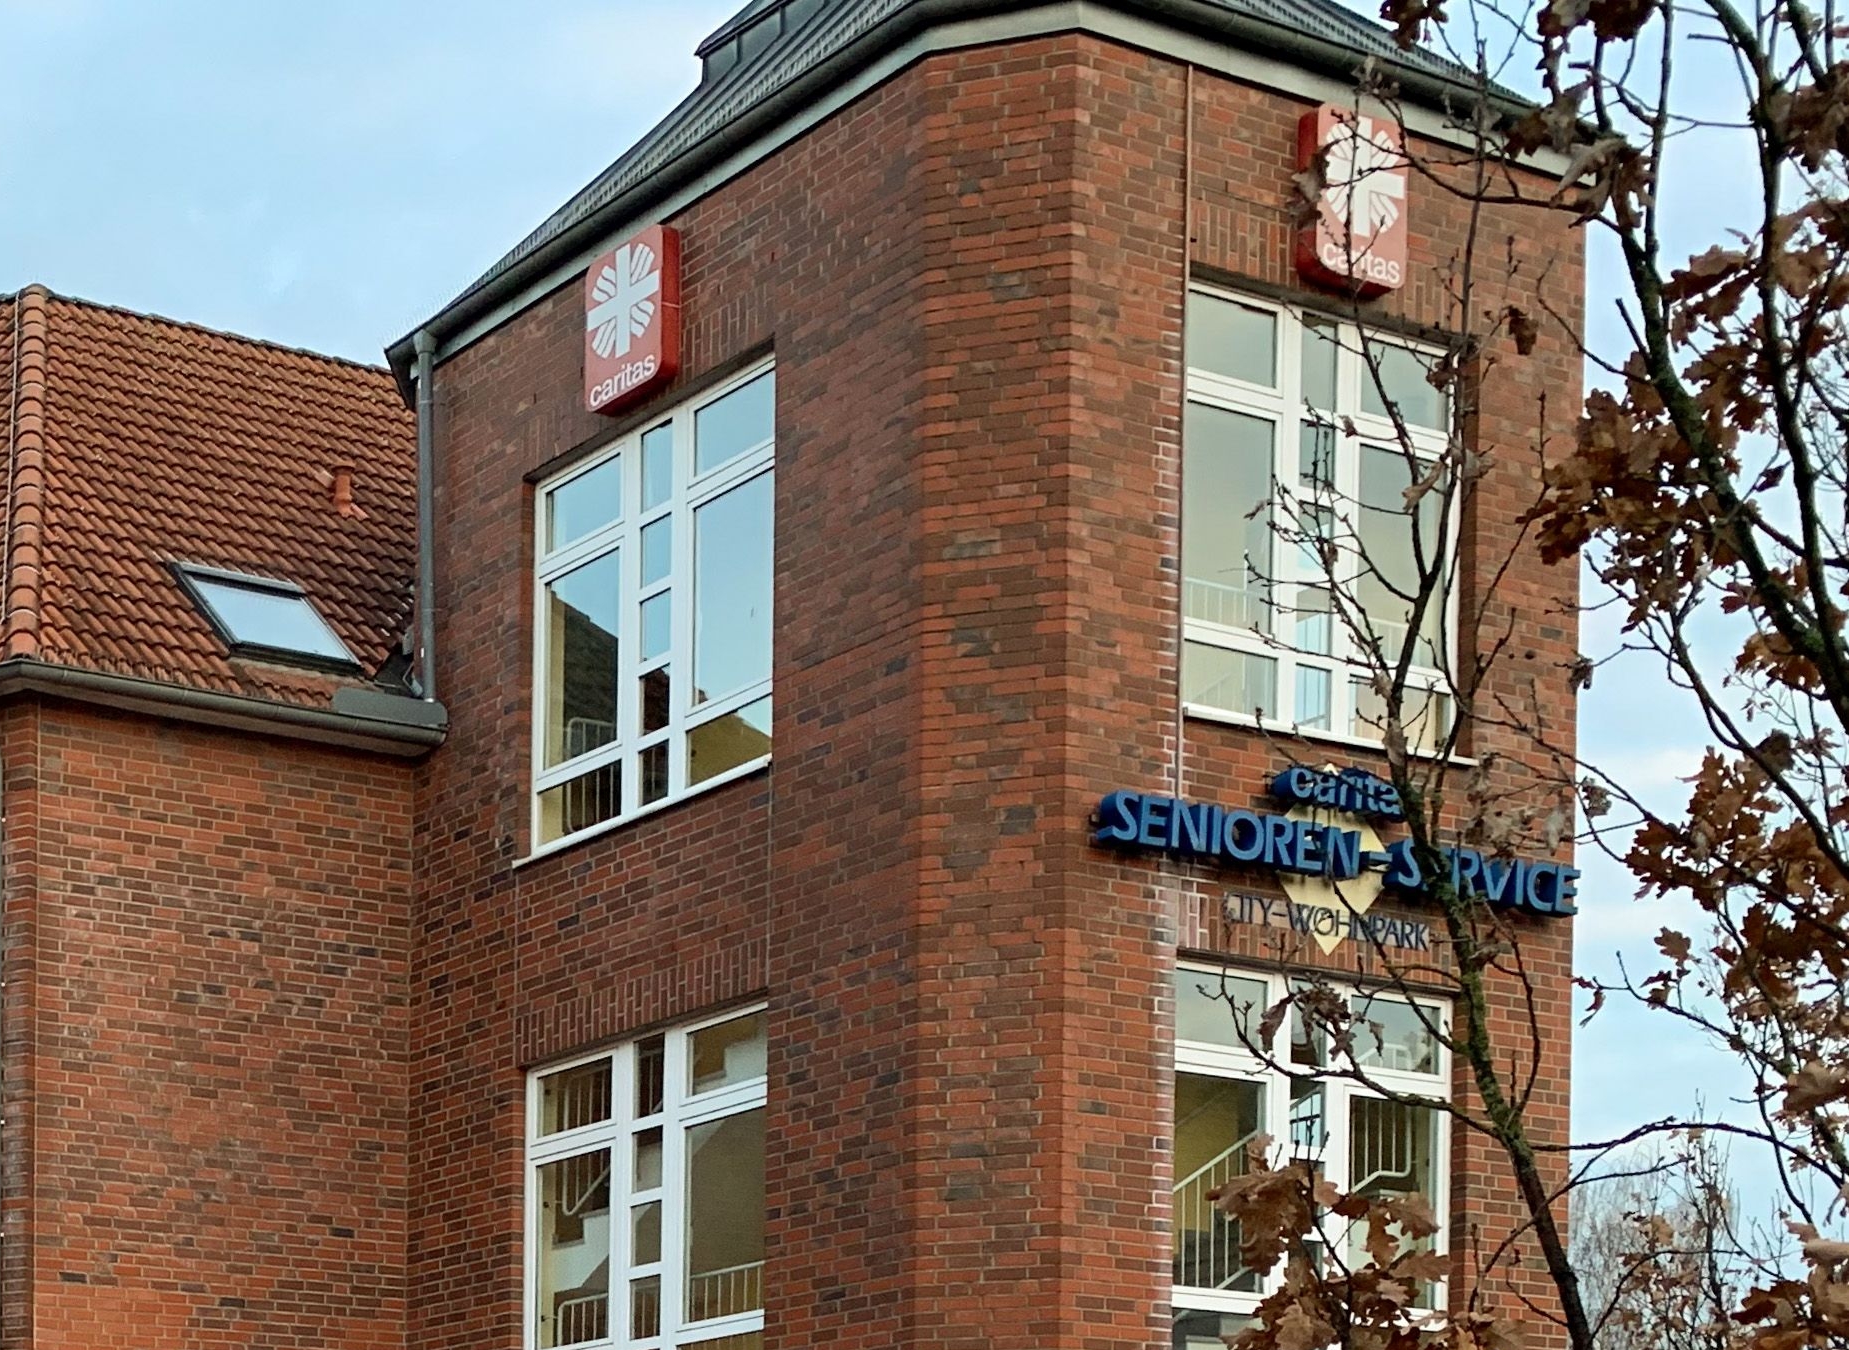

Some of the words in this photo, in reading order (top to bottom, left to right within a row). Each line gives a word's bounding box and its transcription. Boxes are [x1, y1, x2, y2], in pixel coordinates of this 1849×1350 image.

[1321, 242, 1400, 284] caritas
[589, 354, 655, 406] caritas
[1290, 767, 1402, 815] carita
